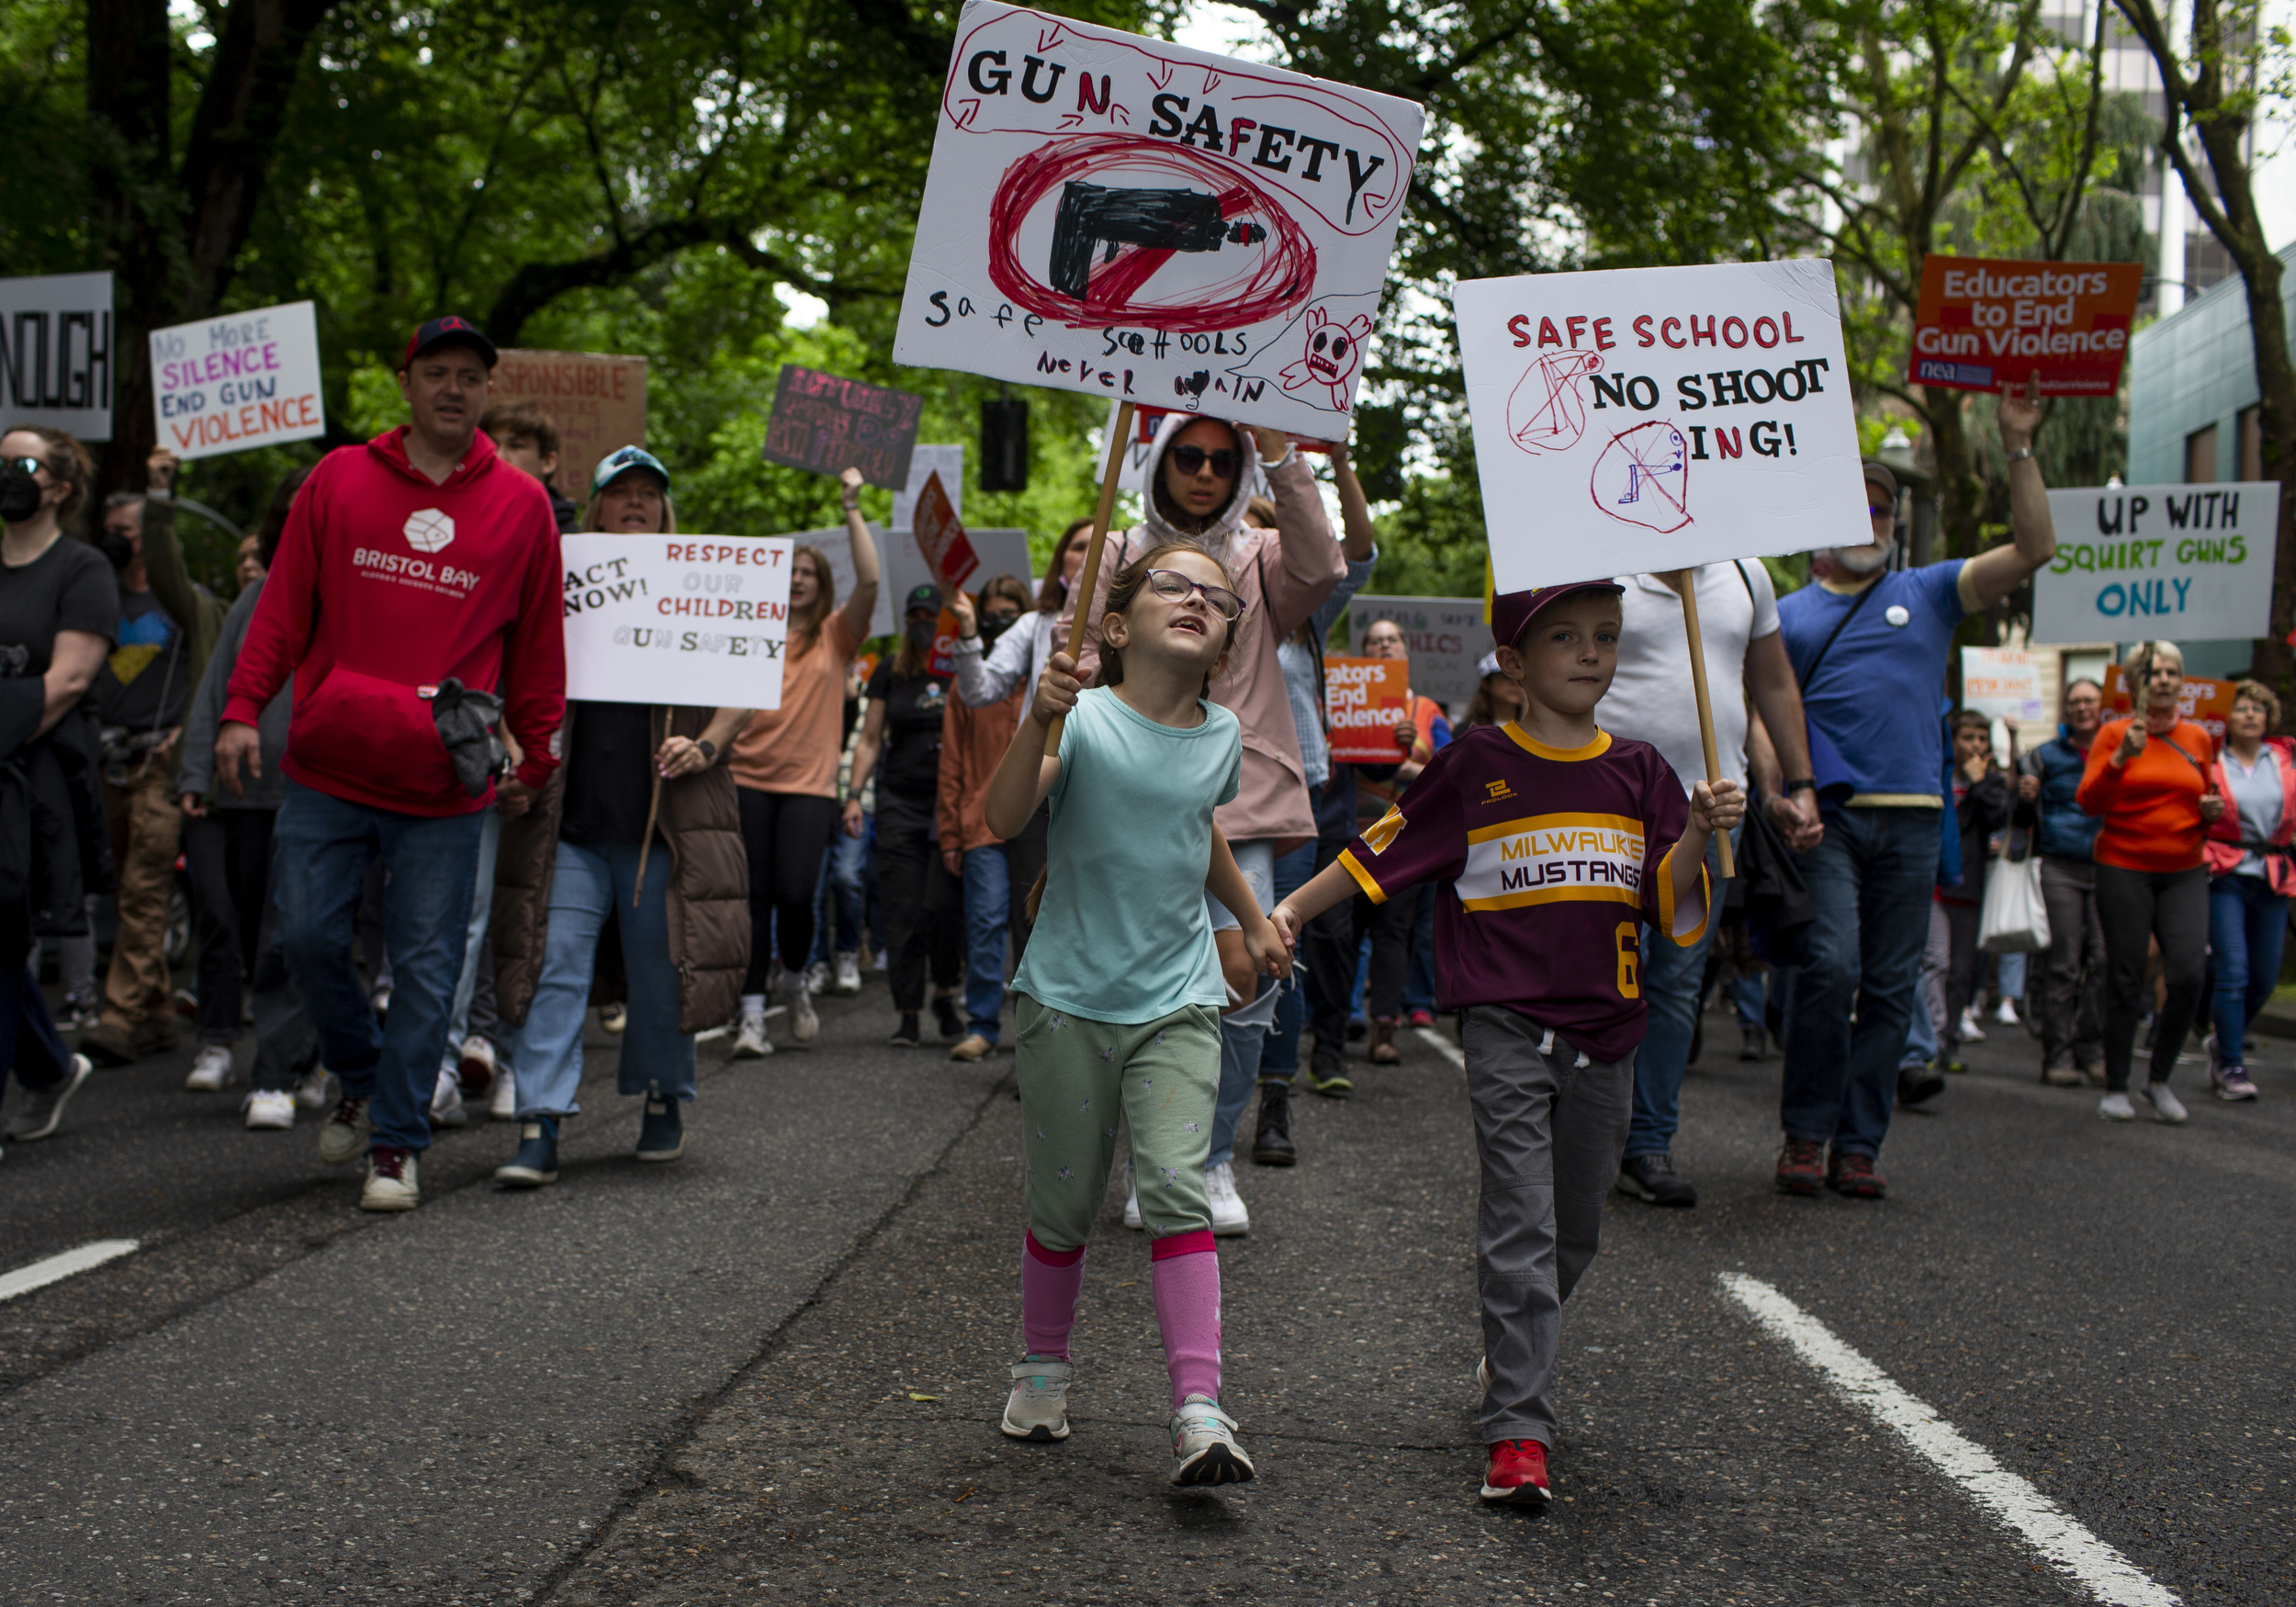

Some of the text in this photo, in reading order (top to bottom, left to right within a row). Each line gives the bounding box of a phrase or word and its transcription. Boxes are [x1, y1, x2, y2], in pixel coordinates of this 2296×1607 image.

[967, 50, 1384, 224] GUN SAFETY
[1942, 269, 2107, 298] Educators
[925, 290, 1044, 339] Safe
[1972, 298, 2075, 328] to End
[208, 318, 272, 350] MORE
[1102, 326, 1247, 360] SCHOOLS
[1507, 310, 1806, 352] SAFE SCHOOL
[1916, 324, 2126, 356] Gun Violence
[162, 342, 281, 391] SILENCE
[1921, 361, 1956, 381] nea
[161, 376, 277, 418] END GUN
[1590, 357, 1830, 412] NO SHOOT
[170, 394, 321, 449] VIOLENCE
[1688, 419, 1798, 460] ING!
[2097, 491, 2240, 536] UP WITH
[352, 546, 436, 581] BRISTOL
[439, 565, 481, 592] BAY
[667, 543, 784, 568] RESPECT
[2049, 534, 2247, 575] SQUIRT GUNS
[563, 556, 629, 592] ACT
[682, 570, 744, 595] OUR
[563, 578, 648, 618] NOW!
[658, 597, 786, 621] CHILDREN
[2096, 578, 2192, 617] ONLY
[612, 624, 786, 659] GUN SAFETY
[1323, 663, 1387, 683] ators
[1325, 683, 1367, 706] End
[1329, 706, 1405, 729] iolence
[1480, 792, 1519, 806] PROLOOK
[1500, 860, 1642, 891] MUSTANGS
[1615, 921, 1641, 999] 6
